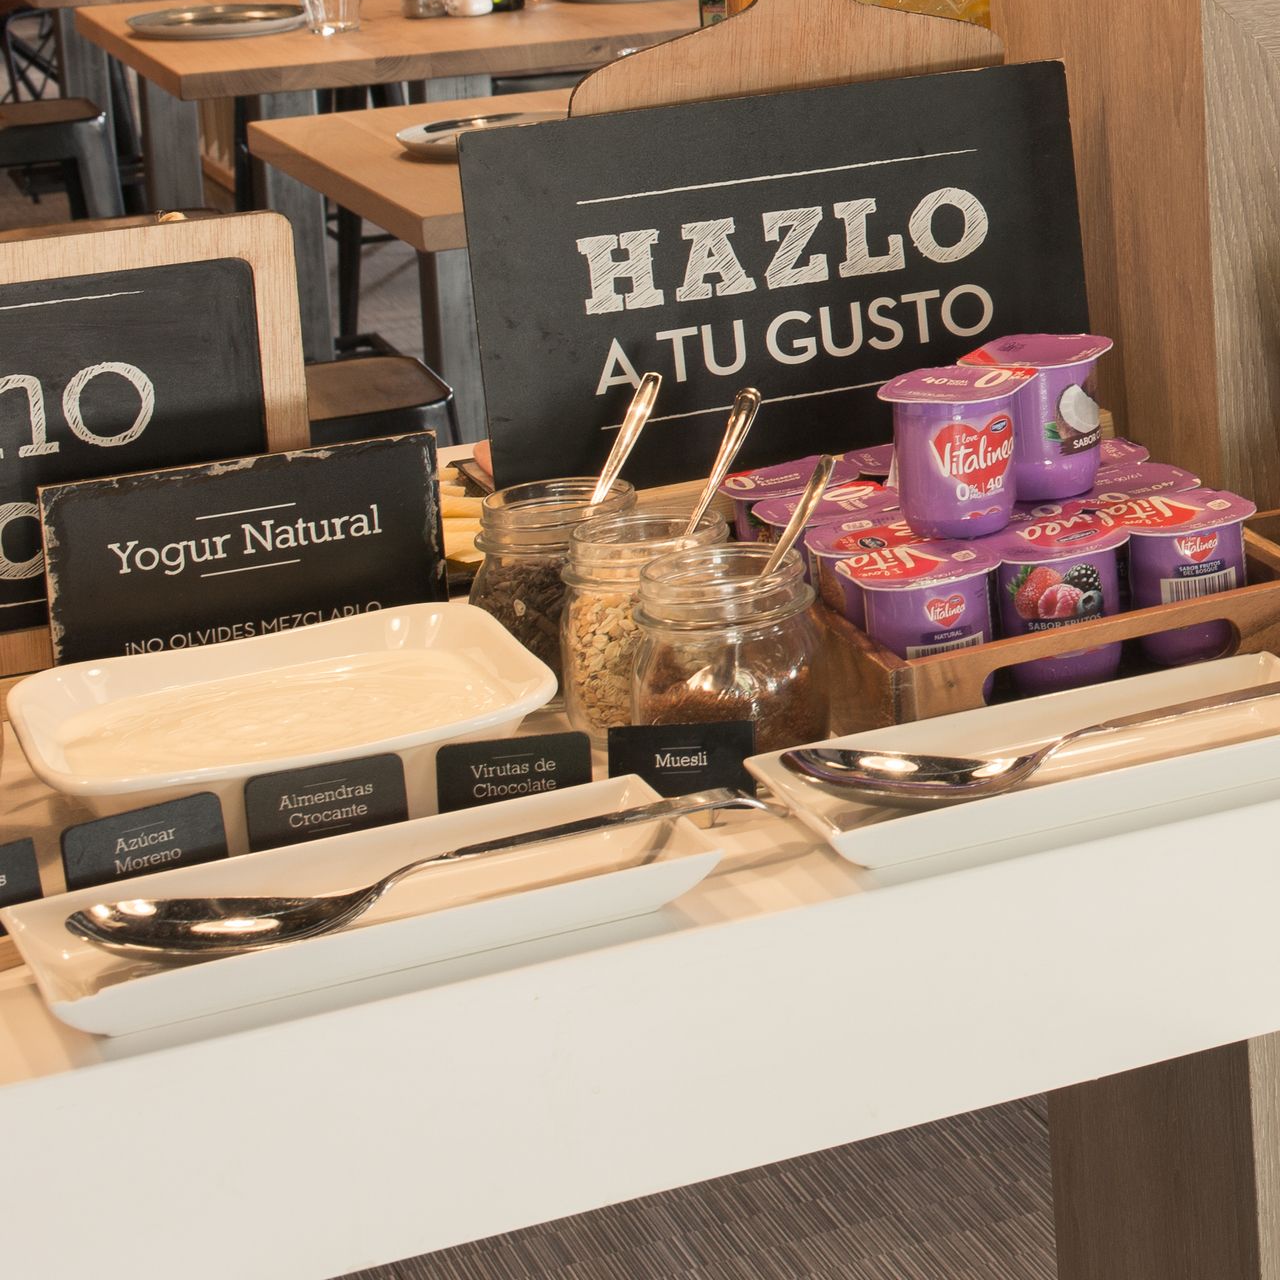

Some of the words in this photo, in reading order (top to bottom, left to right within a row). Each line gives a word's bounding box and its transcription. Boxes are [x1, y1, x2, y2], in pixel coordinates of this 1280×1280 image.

[576, 187, 989, 315] HAZLO
[595, 337, 641, 396] A
[656, 319, 747, 382] TU
[766, 283, 994, 365] GUSTO
[1072, 432, 1097, 449] SABOR
[929, 436, 1014, 477] Vitalinea
[1016, 496, 1205, 541] Vitalinea
[107, 534, 231, 577] Yogur
[241, 504, 383, 555] Natural
[1175, 535, 1220, 557] Vitalinea
[1178, 564, 1198, 572] SABOR
[1198, 561, 1221, 570] FRUTOS
[1195, 567, 1218, 575] BOSQUE
[926, 602, 966, 622] Vitalinea
[169, 622, 256, 650] OLVIDES
[934, 629, 963, 640] NATURAL
[1028, 620, 1061, 631] SABOR
[471, 761, 529, 780] Virutas
[534, 758, 556, 772] de
[655, 751, 708, 768] Muesli
[279, 784, 374, 811] Almendras
[473, 777, 557, 799] Chocolate
[289, 803, 368, 828] Crocante
[115, 828, 176, 855] Azúcar
[114, 847, 182, 875] Moreno
